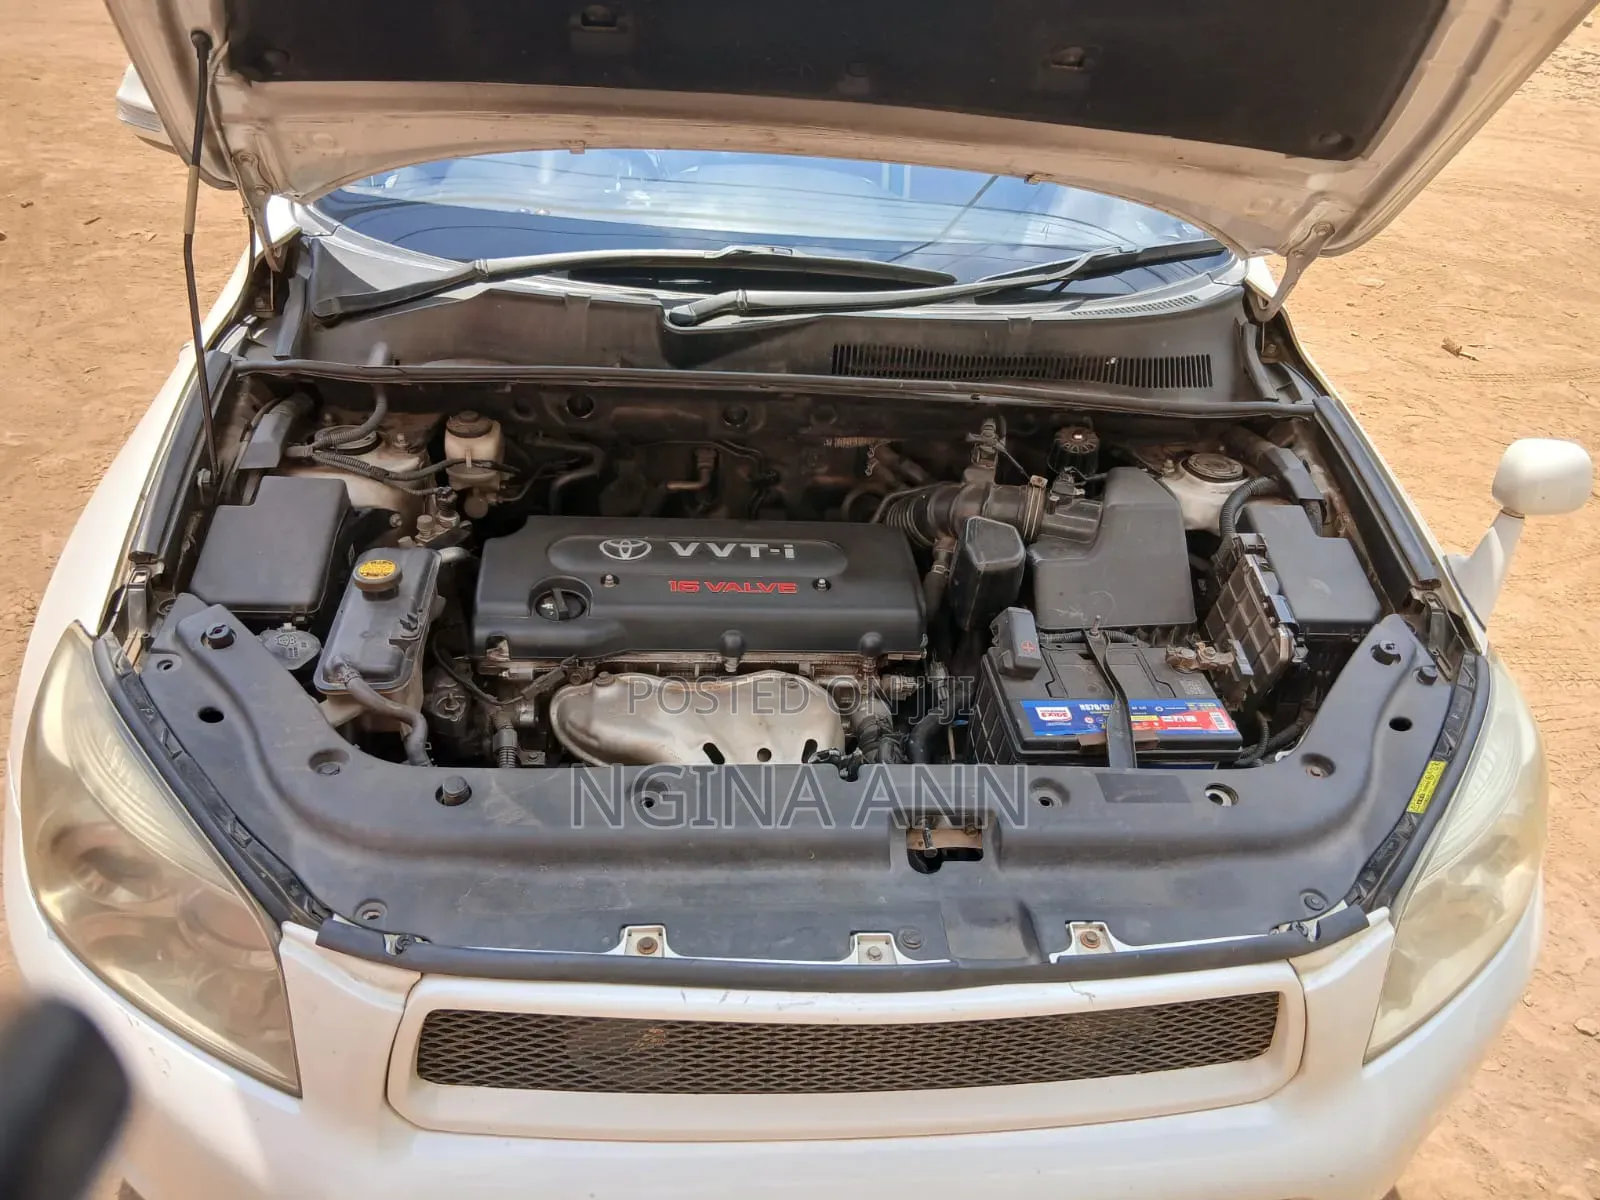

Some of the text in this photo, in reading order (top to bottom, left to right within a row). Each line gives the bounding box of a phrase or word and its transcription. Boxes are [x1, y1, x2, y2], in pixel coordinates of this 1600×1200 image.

[668, 541, 795, 559] VVT-i
[668, 580, 798, 594] 16 VALVE
